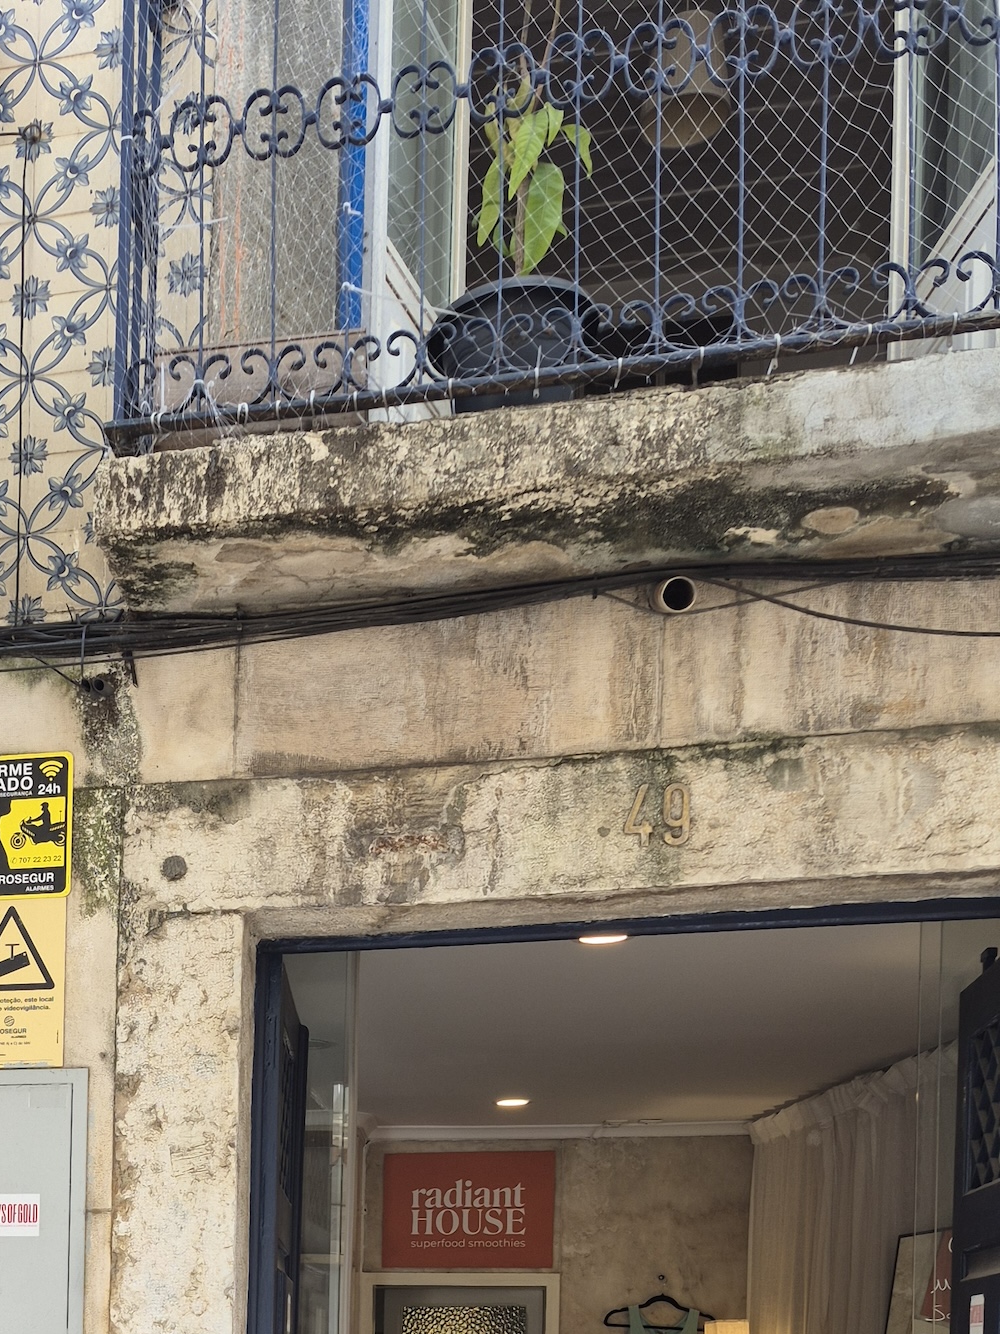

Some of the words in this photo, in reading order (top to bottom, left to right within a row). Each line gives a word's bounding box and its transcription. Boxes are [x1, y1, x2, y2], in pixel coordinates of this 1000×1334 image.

[37, 783, 61, 795] 24h
[411, 1178, 526, 1209] radiant
[7, 1203, 17, 1224] OF
[17, 1203, 38, 1224] GOLD
[411, 1208, 526, 1236] HOUSE
[411, 1238, 466, 1250] superfood
[468, 1238, 526, 1248] smoothies
